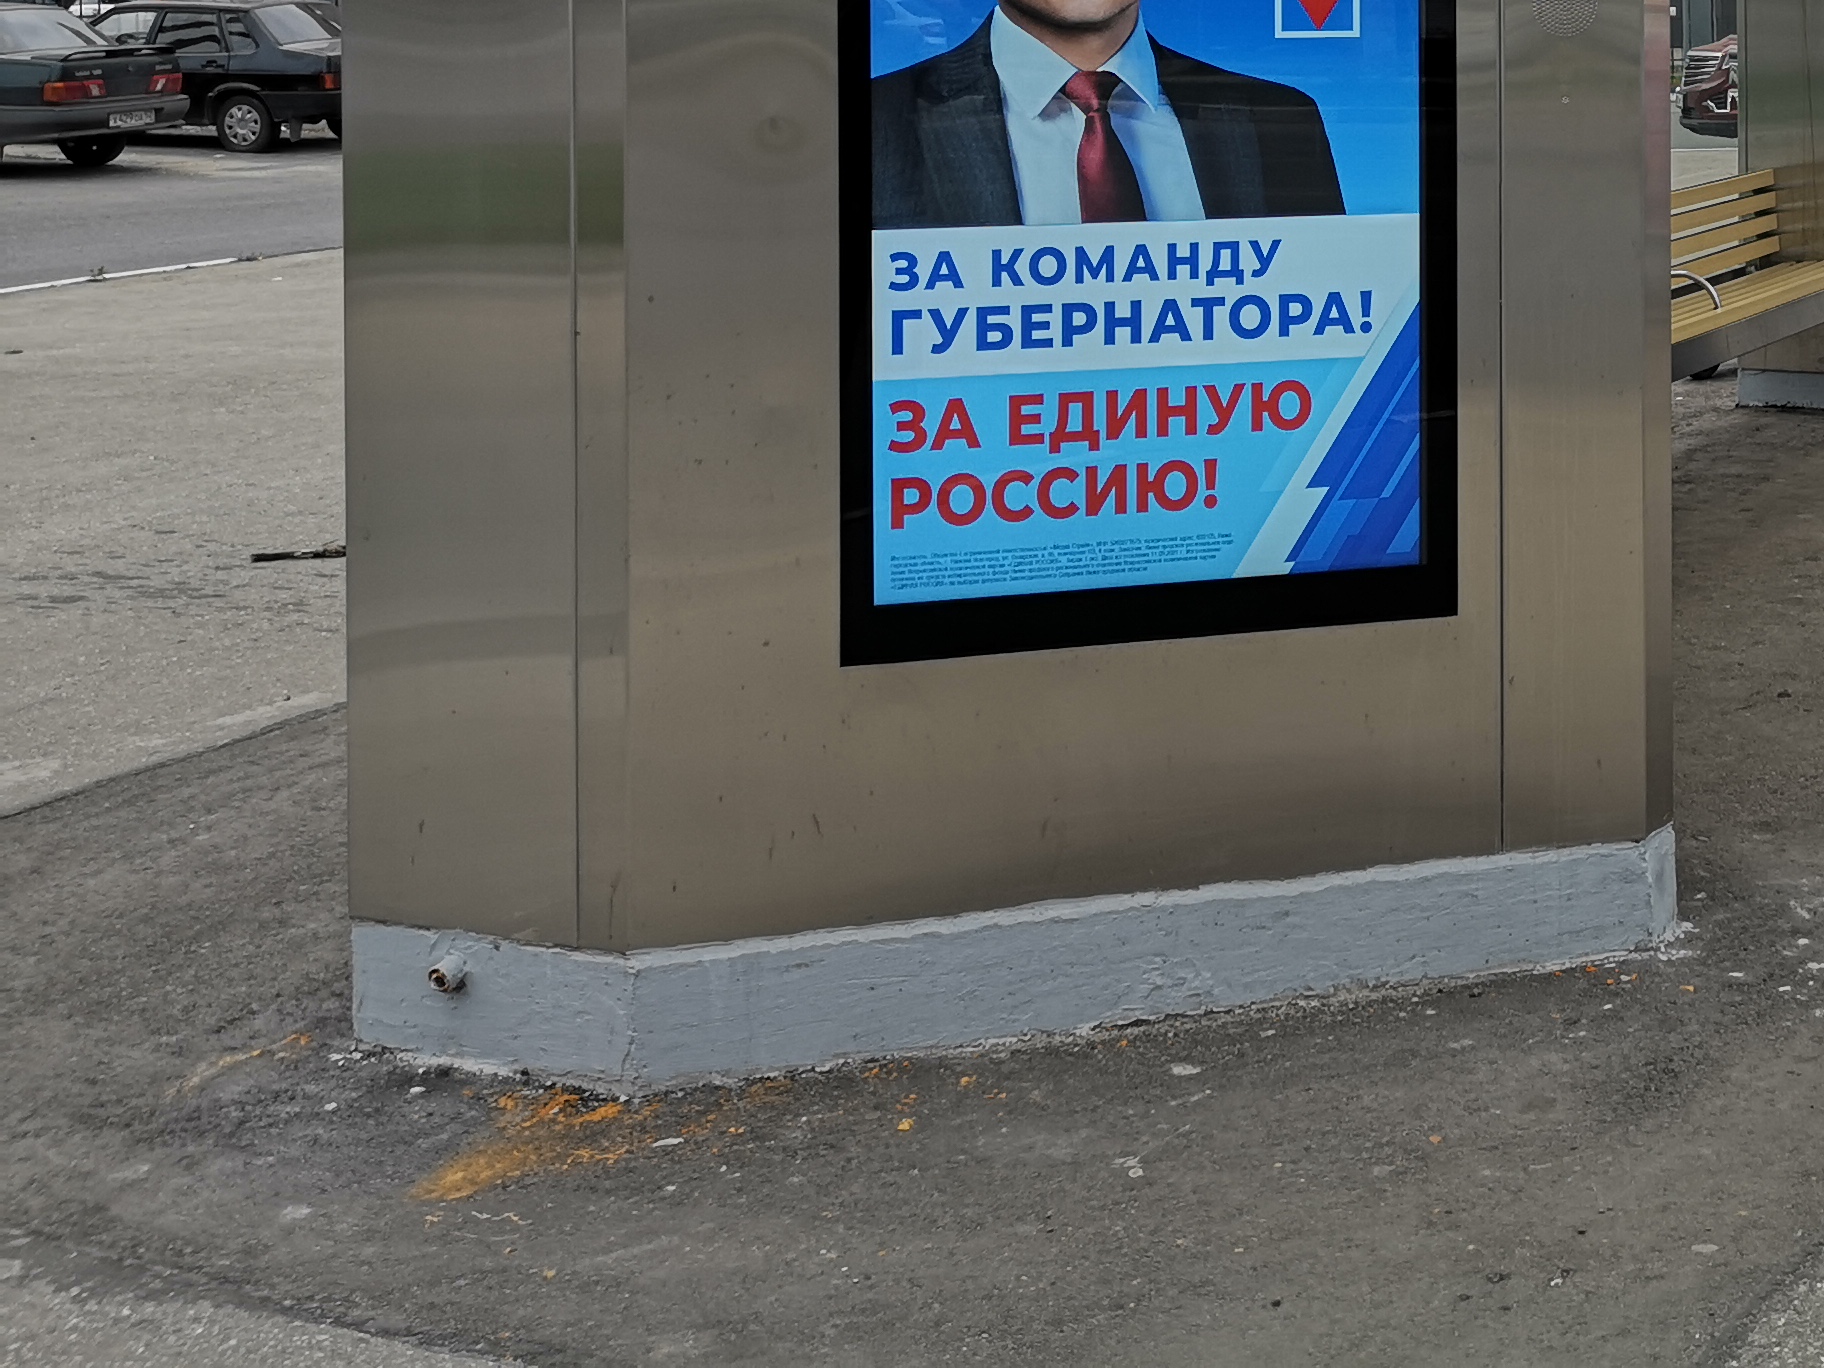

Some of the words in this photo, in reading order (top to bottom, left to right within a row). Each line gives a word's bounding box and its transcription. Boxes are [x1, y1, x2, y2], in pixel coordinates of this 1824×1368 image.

[888, 250, 965, 292] ЗА
[990, 238, 1282, 288] КОМАНДУ
[890, 289, 1374, 356] ГУБЕРНАТОРА!
[888, 397, 982, 455] ЗА
[1007, 379, 1313, 455] ЕДИНУЮ
[890, 458, 1219, 530] РОССИЮ!
